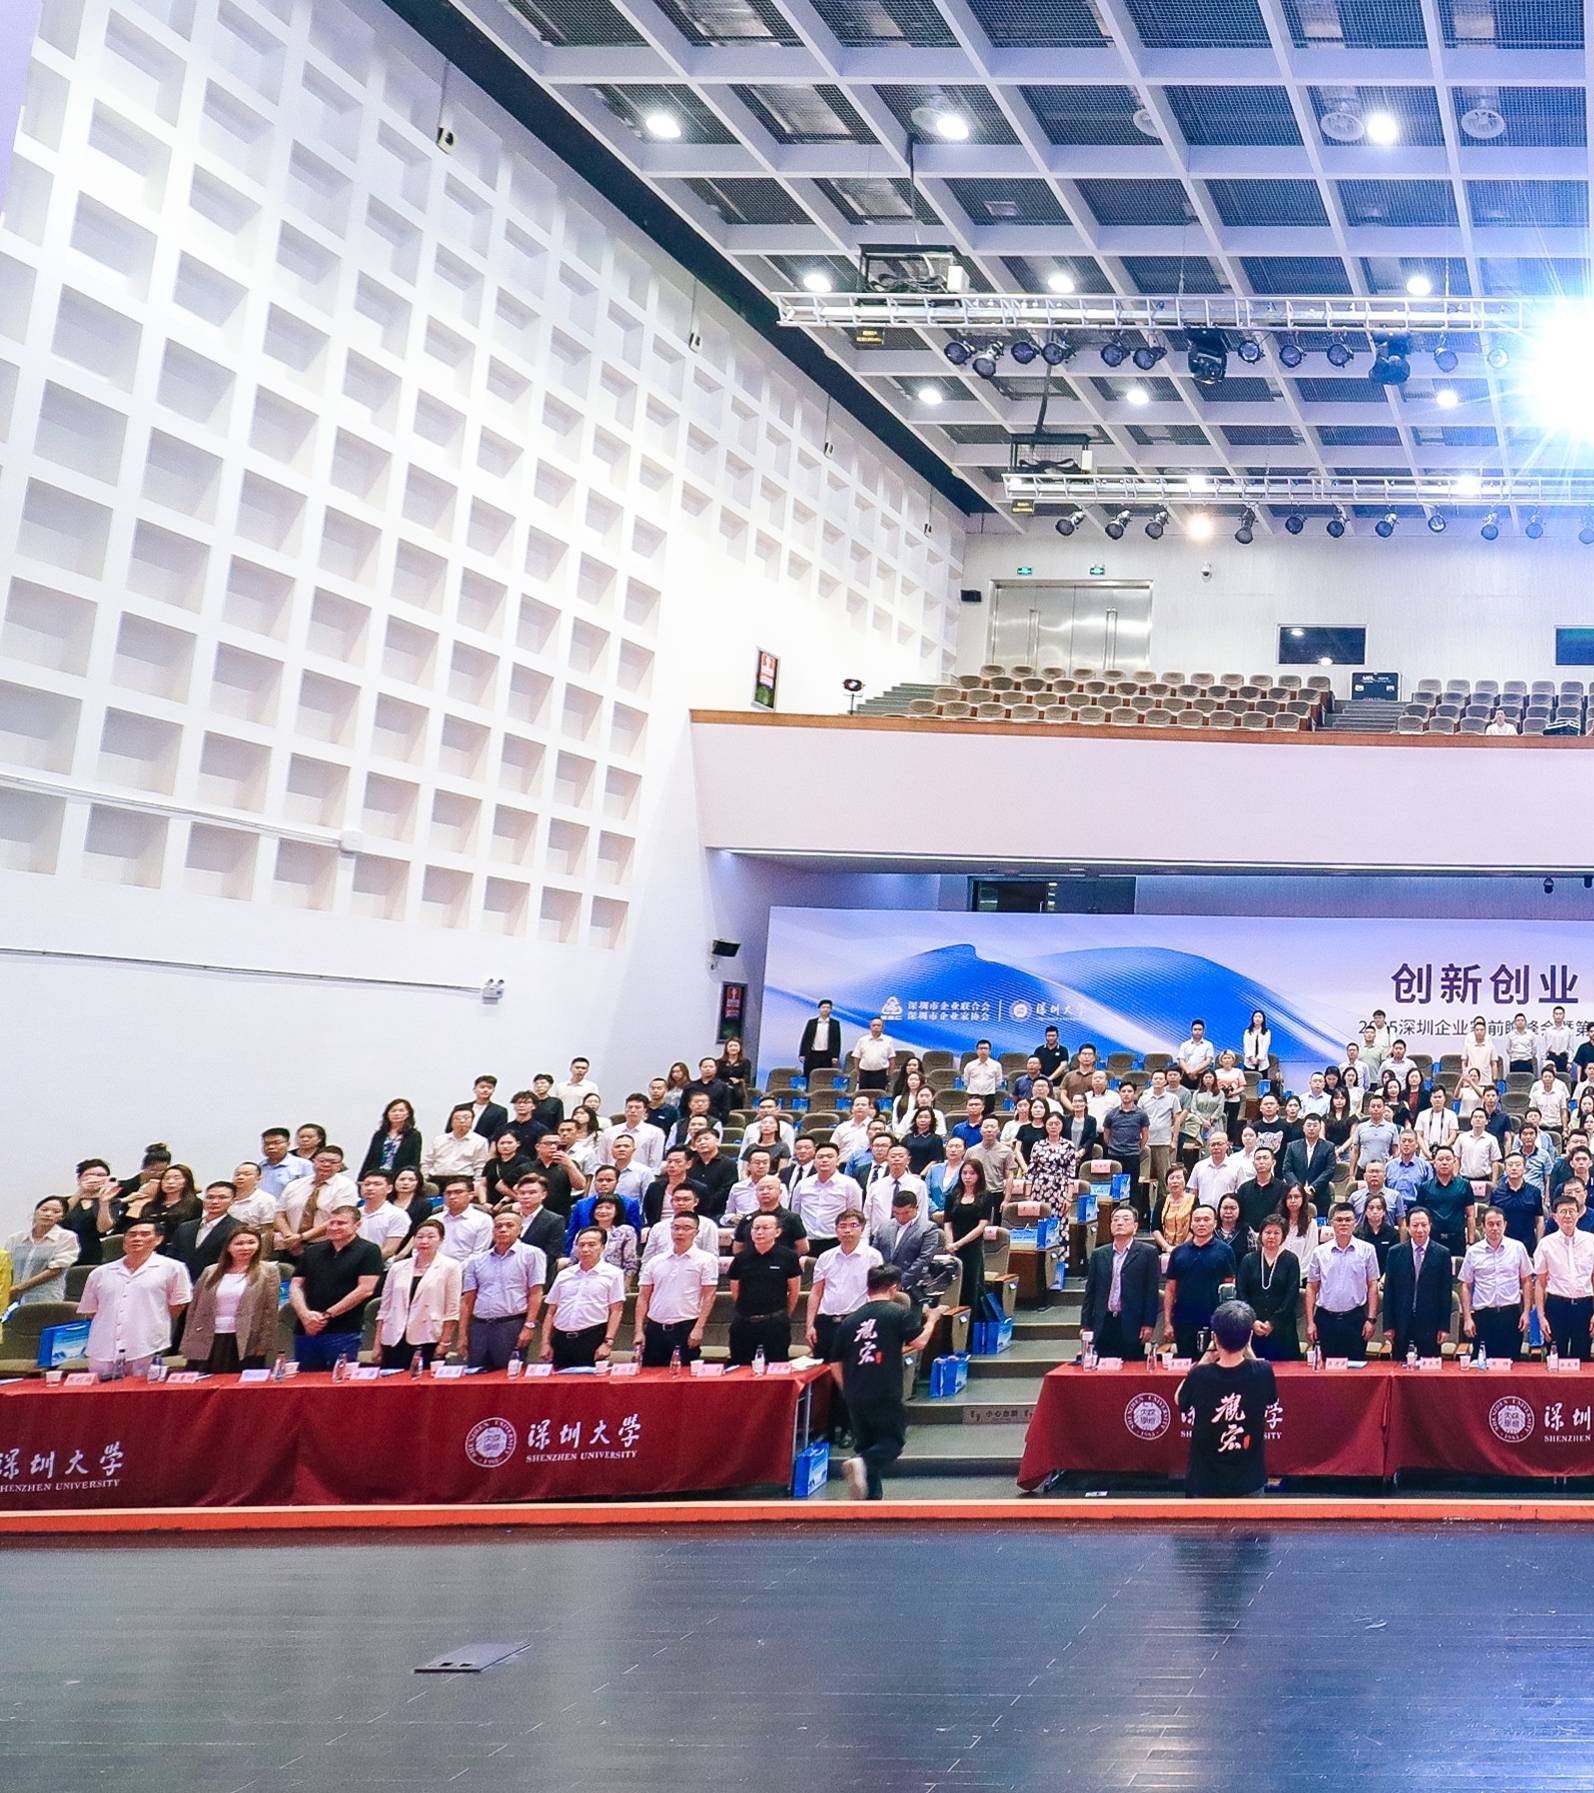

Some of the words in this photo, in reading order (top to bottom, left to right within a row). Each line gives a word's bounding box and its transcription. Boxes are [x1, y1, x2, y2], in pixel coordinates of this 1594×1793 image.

[1391, 963, 1579, 1005] 创新创业
[527, 1413, 641, 1450] 深圳大学
[1544, 1435, 1591, 1443] SHENZHEN
[526, 1453, 578, 1463] SHENZHEN
[580, 1450, 637, 1461] UNIVERSITY
[56, 1479, 120, 1490] UNIVERSITY
